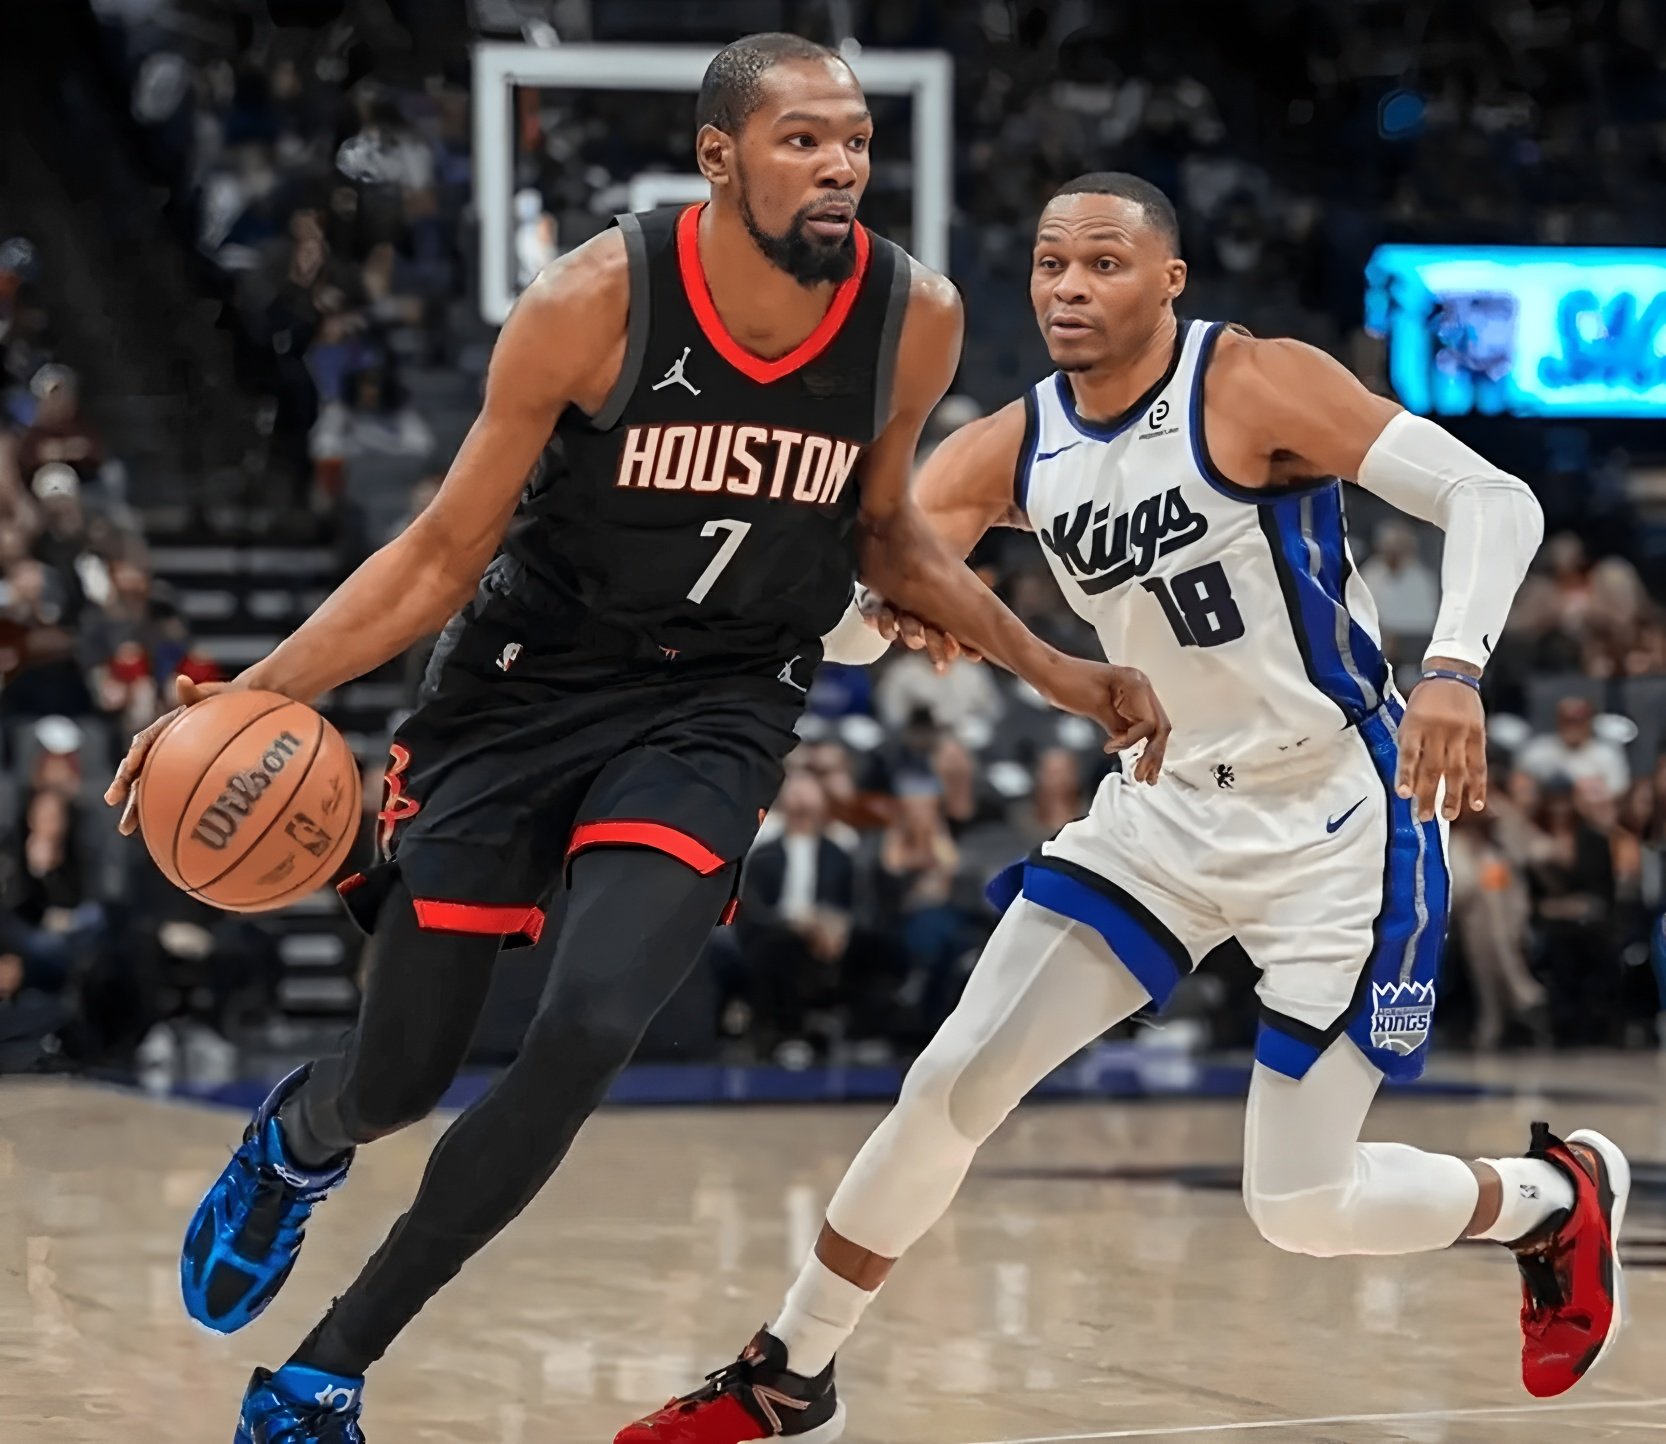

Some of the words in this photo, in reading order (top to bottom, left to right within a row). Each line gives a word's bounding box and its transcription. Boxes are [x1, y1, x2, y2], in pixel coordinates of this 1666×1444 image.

[616, 425, 861, 504] HOUSTON
[686, 518, 752, 605] 7
[1040, 485, 1208, 596] Kings
[1139, 560, 1246, 648] 18
[190, 730, 301, 850] Wilson
[1373, 1014, 1428, 1032] KINGS
